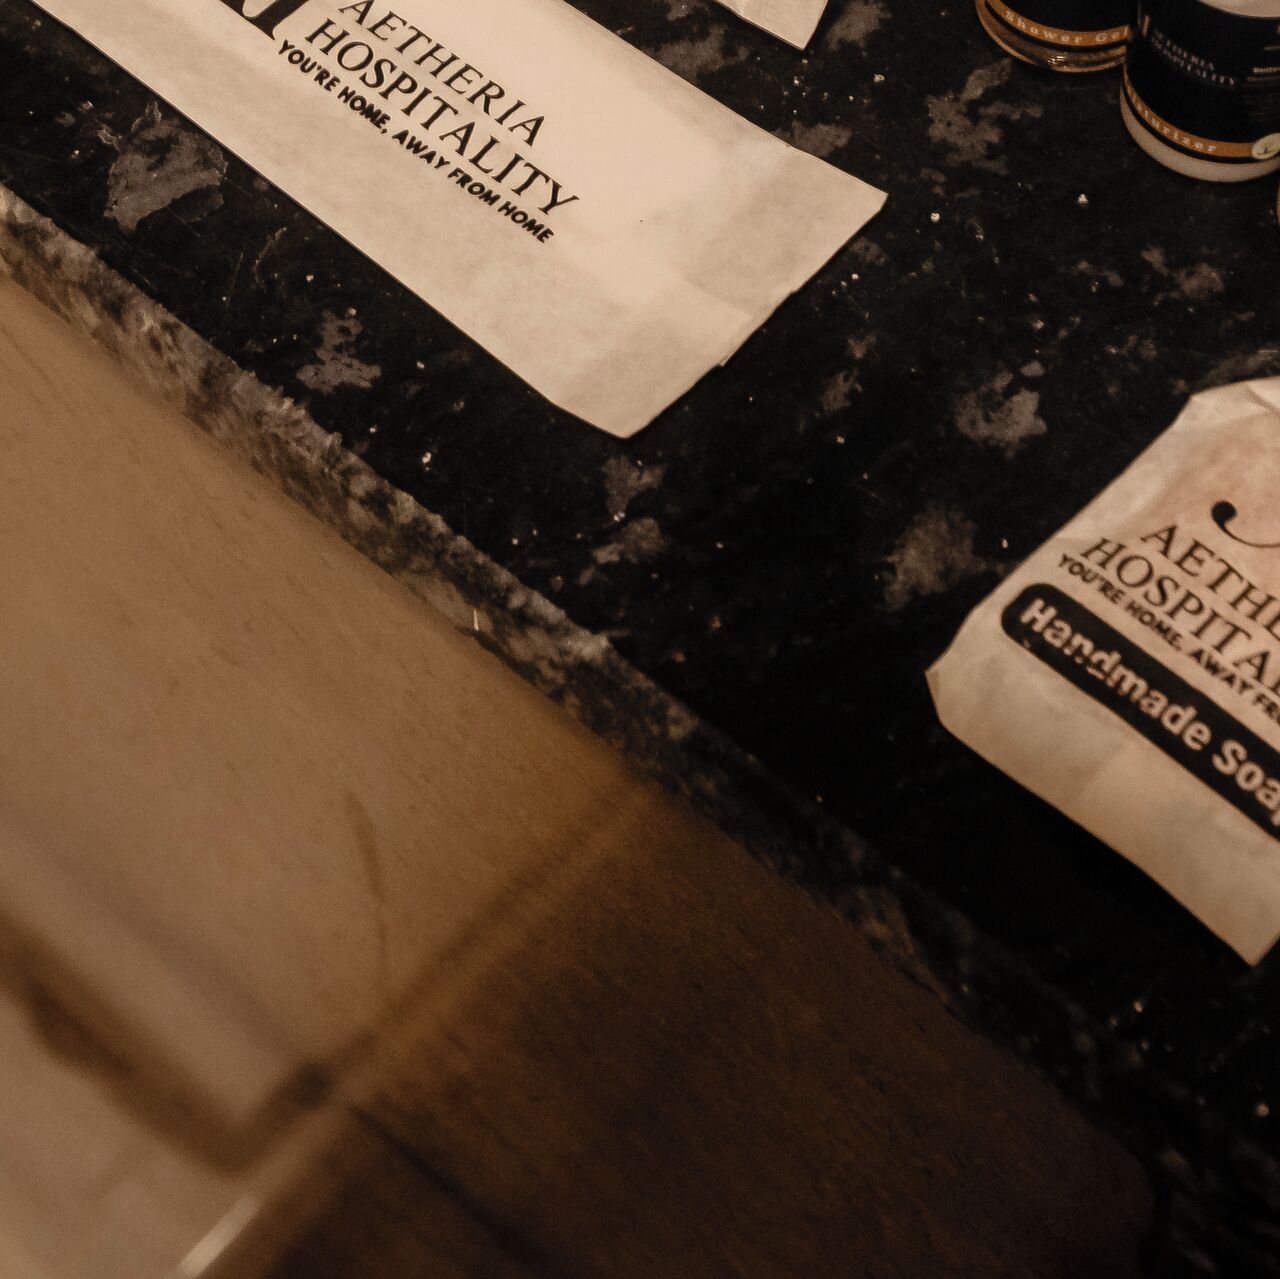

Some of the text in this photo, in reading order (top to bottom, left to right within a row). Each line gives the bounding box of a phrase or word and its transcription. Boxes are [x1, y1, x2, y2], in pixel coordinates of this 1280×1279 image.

[1005, 9, 1083, 43] Shower
[278, 39, 554, 244] YOU'RE HOME, AWAY FROM HOME
[304, 17, 580, 217] HOSPITALITY
[1020, 597, 1213, 752] Handmade
[1058, 553, 1125, 606] YOU'RE
[1191, 647, 1253, 700] AWAY
